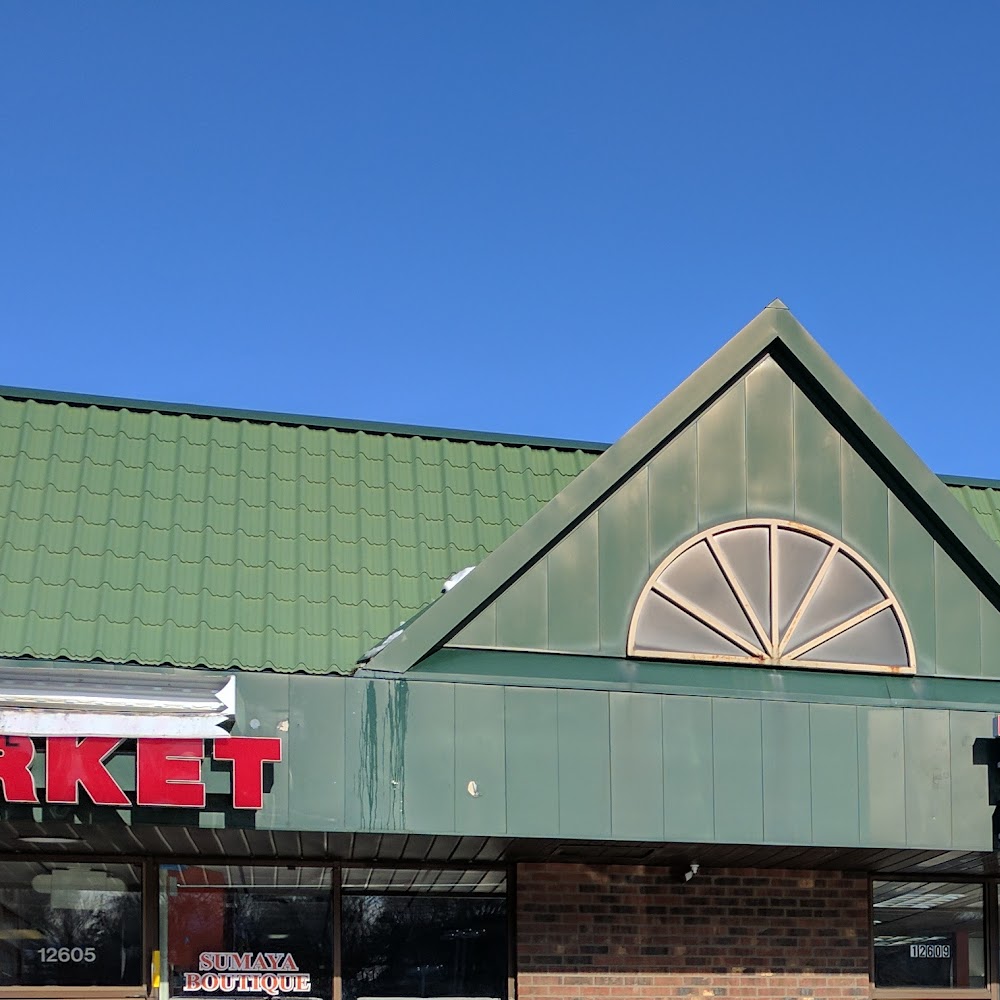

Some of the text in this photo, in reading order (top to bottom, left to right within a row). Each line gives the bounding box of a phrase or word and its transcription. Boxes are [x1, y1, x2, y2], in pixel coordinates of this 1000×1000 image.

[37, 947, 97, 963] 12605
[910, 944, 950, 958] 12609
[199, 952, 299, 971] SUMAYA
[183, 972, 312, 995] BOUTIQUE
